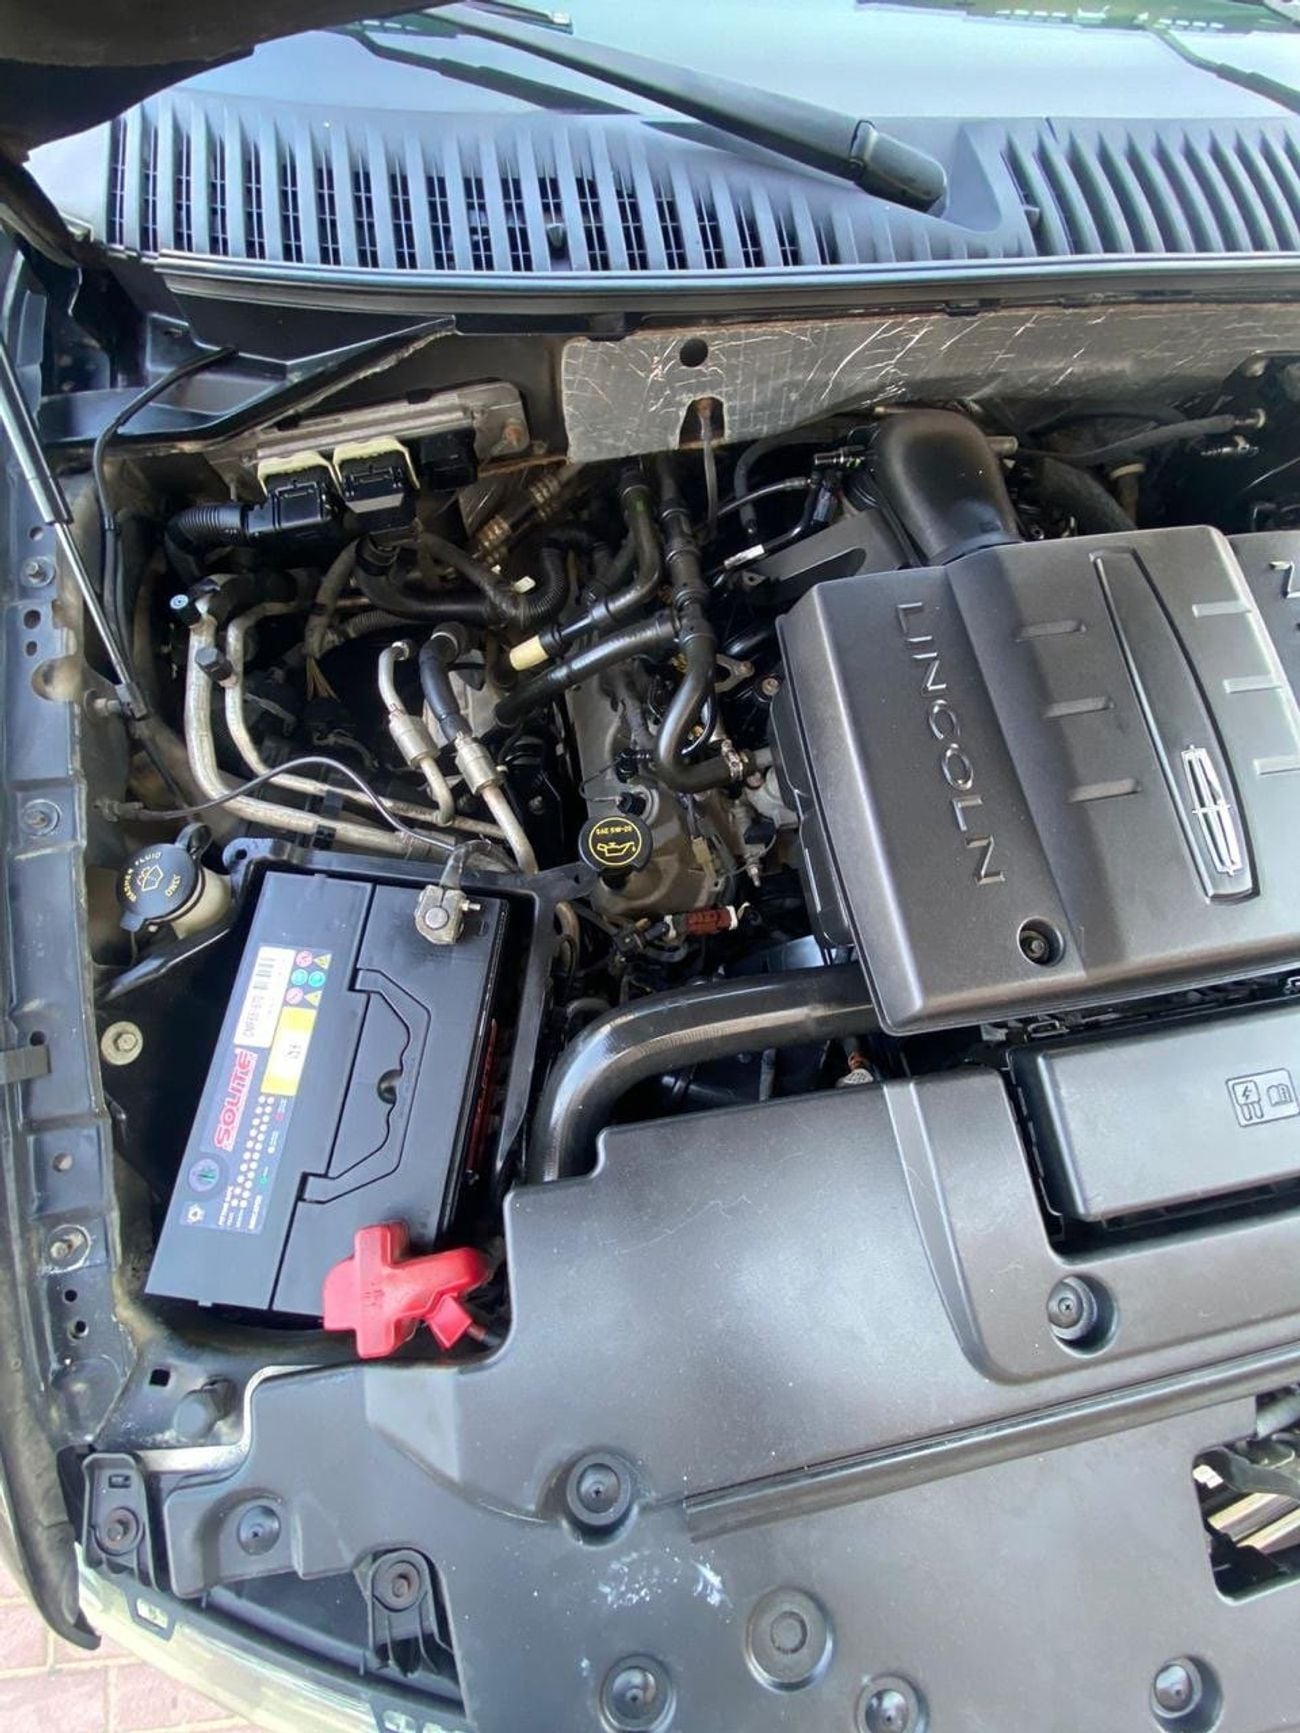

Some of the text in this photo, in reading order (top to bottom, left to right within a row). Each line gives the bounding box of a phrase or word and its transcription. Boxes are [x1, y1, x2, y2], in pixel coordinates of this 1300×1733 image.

[896, 601, 1006, 886] LINCOLN
[164, 873, 181, 898] ONLY
[214, 1049, 257, 1151] SOLITE
